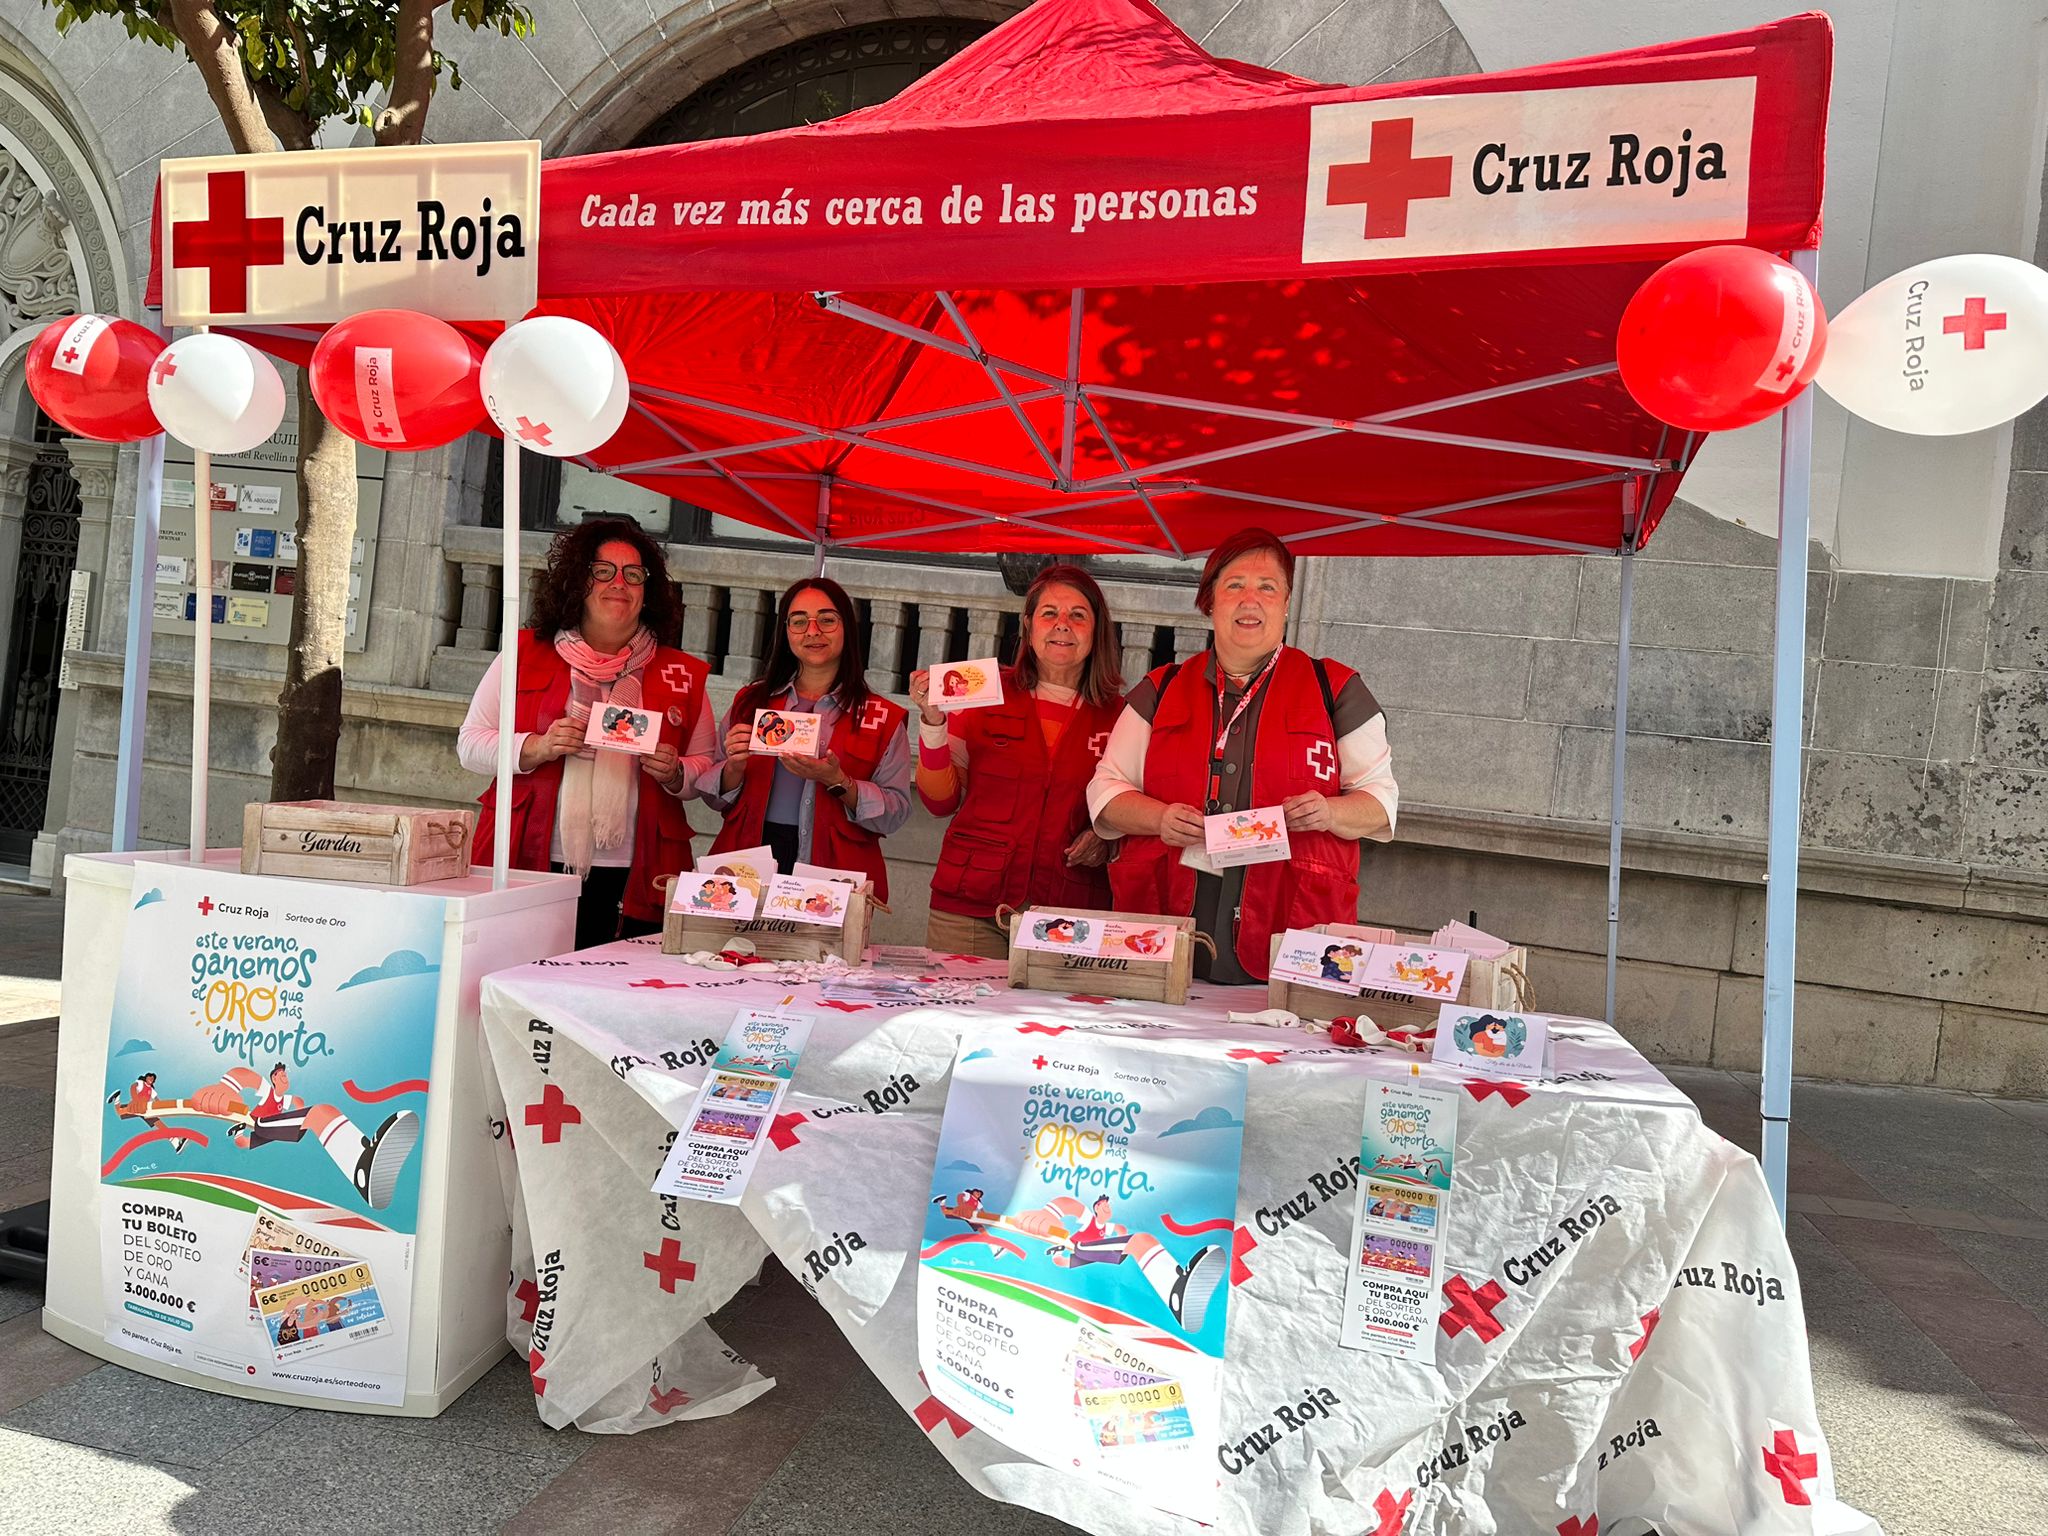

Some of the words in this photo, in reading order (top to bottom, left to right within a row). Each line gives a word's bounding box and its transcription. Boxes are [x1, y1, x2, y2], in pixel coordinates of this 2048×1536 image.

[1472, 143, 1589, 196] Cruz
[1606, 128, 1727, 198] Roja
[580, 194, 656, 228] Cada
[673, 198, 723, 226] vez
[737, 186, 809, 226] más
[825, 197, 923, 226] cerca
[941, 184, 983, 224] de
[1000, 183, 1056, 224] las
[1071, 182, 1259, 233] personas
[296, 205, 402, 266] Cruz
[417, 196, 526, 277] Roja
[1905, 280, 1930, 331] Cruz
[366, 356, 380, 386] Roja
[1902, 336, 1930, 392] Roja
[371, 388, 383, 418] Cruz
[299, 830, 362, 854] Garden
[218, 903, 242, 915] Cruz
[245, 906, 270, 919] Roja
[285, 913, 314, 924] Sorteo
[315, 915, 328, 926] de
[329, 918, 346, 927] Oro
[196, 931, 229, 950] este
[233, 935, 299, 953] verano,
[191, 948, 317, 989] ganemos
[191, 983, 208, 1001] el
[205, 980, 278, 1032] ORO
[280, 989, 304, 1006] que
[278, 1006, 303, 1019] más
[212, 1020, 335, 1068] importa.
[744, 1025, 789, 1036] ganemos
[660, 1036, 720, 1070] Roja
[1052, 1059, 1076, 1073] Cruz
[1078, 1062, 1100, 1077] Roja
[1113, 1071, 1140, 1084] Sorteo
[1141, 1073, 1151, 1085] de
[1152, 1077, 1167, 1087] Oro
[864, 1069, 921, 1115] Roja
[1029, 1083, 1060, 1099] este
[1065, 1087, 1125, 1105] verano,
[1023, 1099, 1141, 1135] ganemos
[1380, 1107, 1431, 1123] ganemos
[1386, 1117, 1416, 1137] ORO
[688, 1141, 724, 1153] COMPRA
[727, 1148, 749, 1156] AQUÍ
[705, 1151, 739, 1161] BOLETO
[1023, 1125, 1038, 1140] el
[1036, 1121, 1105, 1167] ORO
[1107, 1132, 1129, 1148] que
[1105, 1147, 1128, 1160] más
[1389, 1134, 1438, 1151] importa.
[677, 1159, 690, 1167] DE
[691, 1162, 710, 1170] ORO
[718, 1166, 742, 1175] GANA
[681, 1167, 724, 1179] 3.000.000
[687, 1154, 702, 1163] DEL
[705, 1158, 739, 1168] SORTEO
[1040, 1160, 1156, 1200] importa.
[1254, 1193, 1317, 1238] Cruz
[1309, 1154, 1361, 1204] Roja
[1394, 1188, 1423, 1201] 00000
[122, 1202, 184, 1223] COMPRA
[258, 1215, 275, 1231] 6€
[121, 1218, 142, 1231] TU
[146, 1220, 197, 1244] BOLETO
[1390, 1238, 1418, 1251] 00000
[1502, 1240, 1567, 1287] Cruz
[1558, 1193, 1622, 1244] Roja
[123, 1234, 152, 1249] DEL
[154, 1239, 202, 1263] SORTEO
[124, 1249, 144, 1263] DE
[146, 1254, 173, 1272] ORO
[253, 1255, 270, 1267] 6€
[805, 1229, 868, 1283] Roja
[123, 1265, 133, 1277] Y
[136, 1268, 169, 1289] GANA
[261, 1293, 279, 1306] 6€
[301, 1272, 347, 1296] 00000
[356, 1267, 364, 1280] 0
[537, 1249, 565, 1303] Roja
[1362, 1280, 1403, 1295] COMPRA
[1404, 1288, 1429, 1300] AQUÍ
[1721, 1261, 1785, 1306] Roja
[124, 1281, 184, 1309] 3.000.000
[186, 1300, 197, 1313] €
[937, 1286, 999, 1319] COMPRA
[1366, 1297, 1384, 1308] DEL
[1385, 1301, 1422, 1315] SORTEO
[1368, 1289, 1382, 1298] TU
[1383, 1292, 1421, 1306] BOLETO
[936, 1298, 954, 1314] TU
[957, 1308, 1014, 1339] BOLETO
[1358, 1304, 1371, 1313] DE
[1372, 1307, 1393, 1317] ORO
[1395, 1311, 1402, 1319] Y
[1402, 1313, 1429, 1326] GANA
[1364, 1314, 1410, 1330] 3.000.000
[1412, 1324, 1420, 1332] €
[121, 1327, 132, 1337] Oro
[150, 1338, 163, 1348] Cruz
[162, 1342, 175, 1353] Roja
[532, 1307, 555, 1352] Cruz
[936, 1311, 961, 1332] DEL
[964, 1325, 1019, 1356] SORTEO
[936, 1324, 954, 1341] DE
[956, 1336, 987, 1357] ORO
[1080, 1326, 1095, 1341] 6€
[945, 1343, 984, 1371] GANA
[1076, 1359, 1092, 1372] 6€
[271, 1370, 381, 1391] www.cruzroja.es/sorteodeoro
[936, 1348, 1000, 1393] 3.000.000
[1004, 1388, 1015, 1400] €
[1084, 1396, 1100, 1407] 6€
[1119, 1388, 1161, 1405] 00000
[1169, 1385, 1176, 1396] 0
[1216, 1422, 1281, 1476] Cruz
[1273, 1384, 1341, 1436] Roja
[1610, 1418, 1662, 1460] Roja
[1415, 1440, 1471, 1489] Cruz
[1465, 1407, 1526, 1454] Roja
